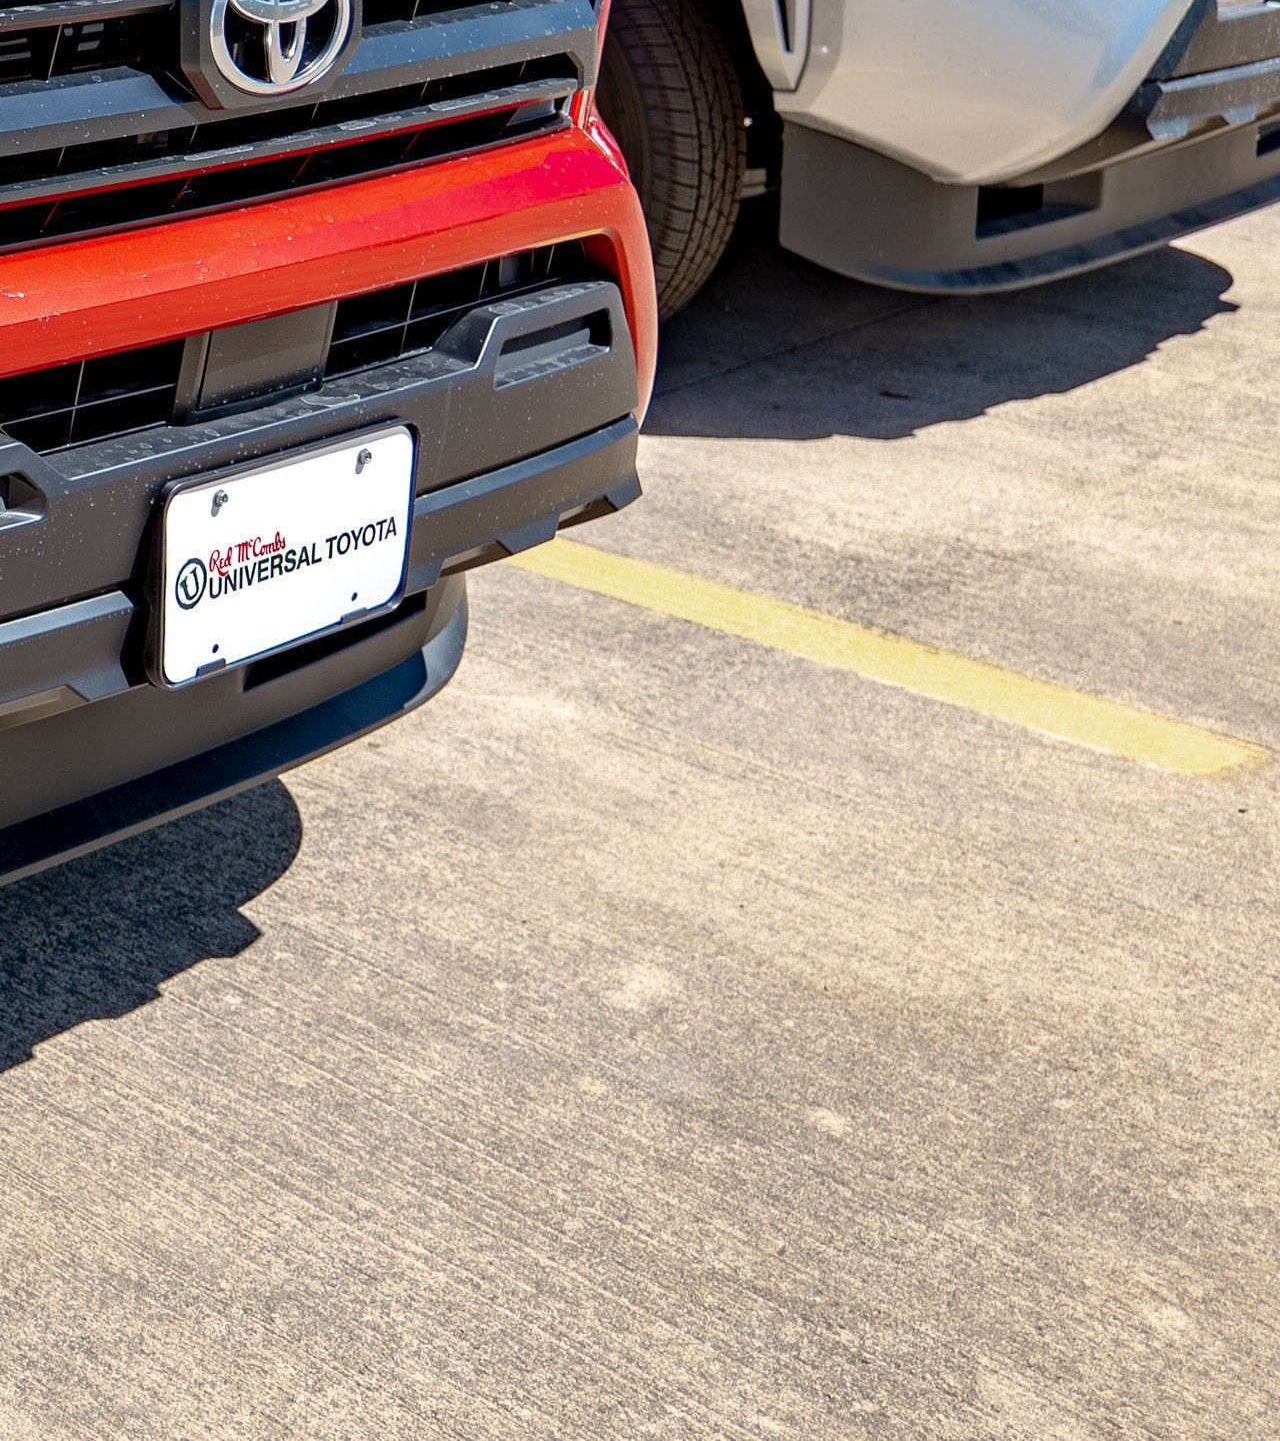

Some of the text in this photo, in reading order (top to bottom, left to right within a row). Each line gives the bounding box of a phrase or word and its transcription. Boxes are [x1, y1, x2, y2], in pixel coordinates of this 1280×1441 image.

[208, 531, 287, 576] Red McCombs
[208, 516, 397, 600] UNIVERSAL TOYOTA
